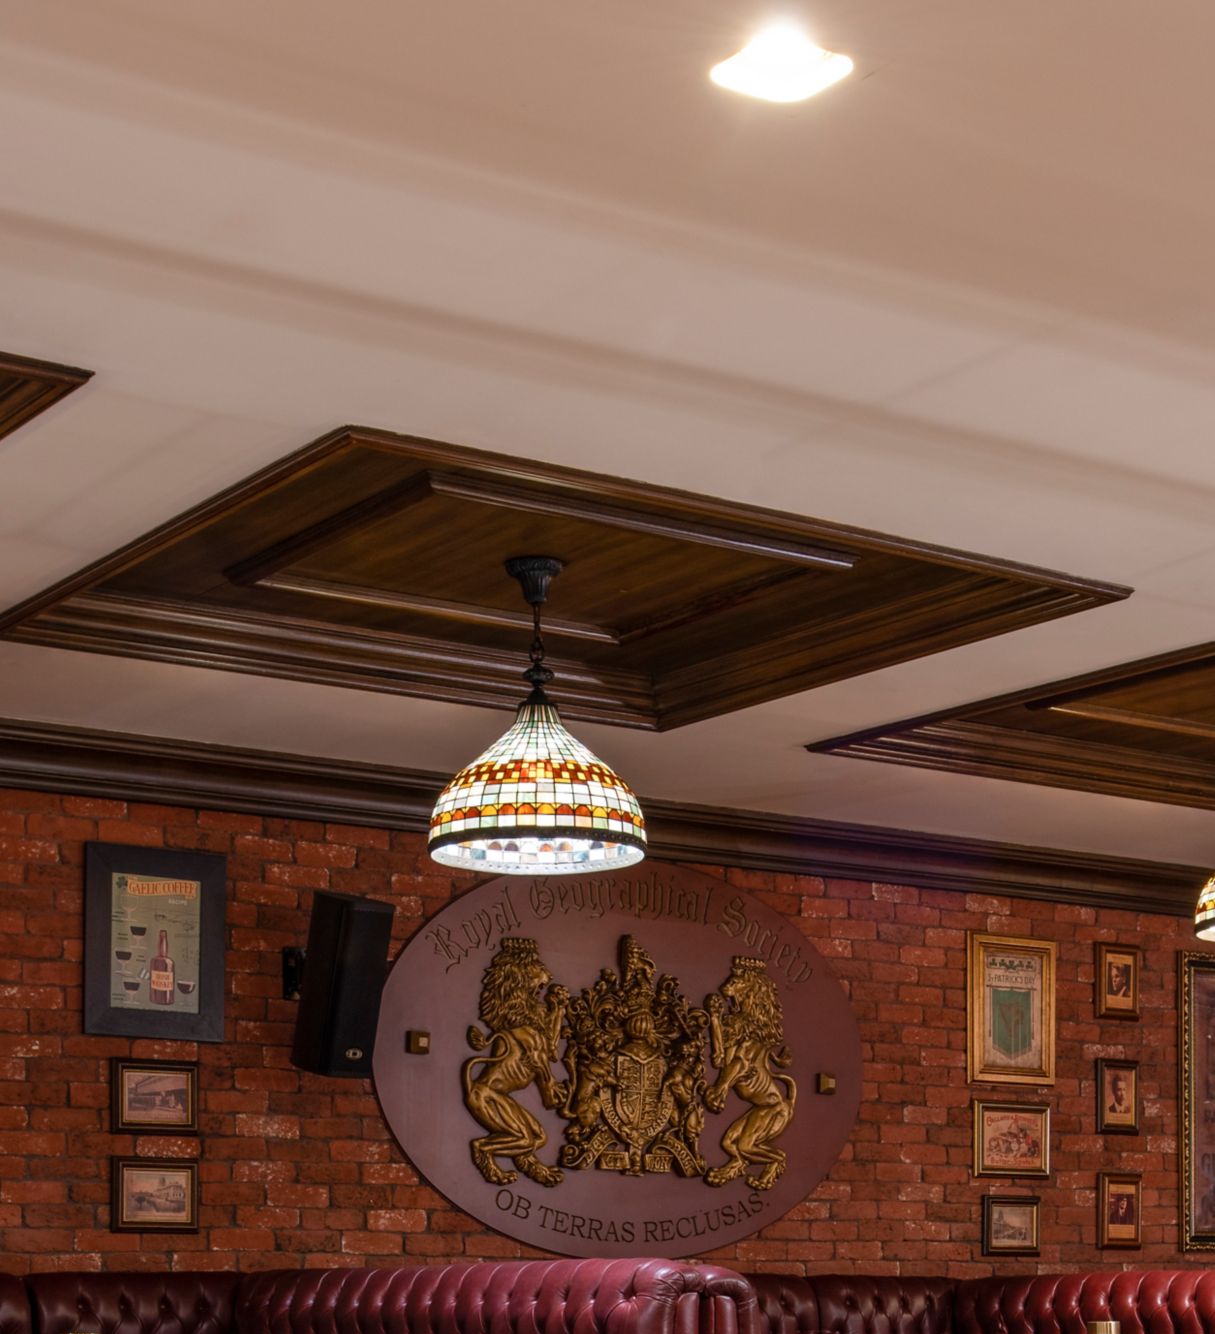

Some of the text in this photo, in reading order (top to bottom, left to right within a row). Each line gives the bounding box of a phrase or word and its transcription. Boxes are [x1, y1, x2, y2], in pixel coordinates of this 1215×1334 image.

[128, 881, 195, 895] GAELIC COFFEE
[425, 872, 815, 985] Royal Geographical Society
[495, 1188, 533, 1221] OB
[537, 1204, 636, 1244] TERRAS
